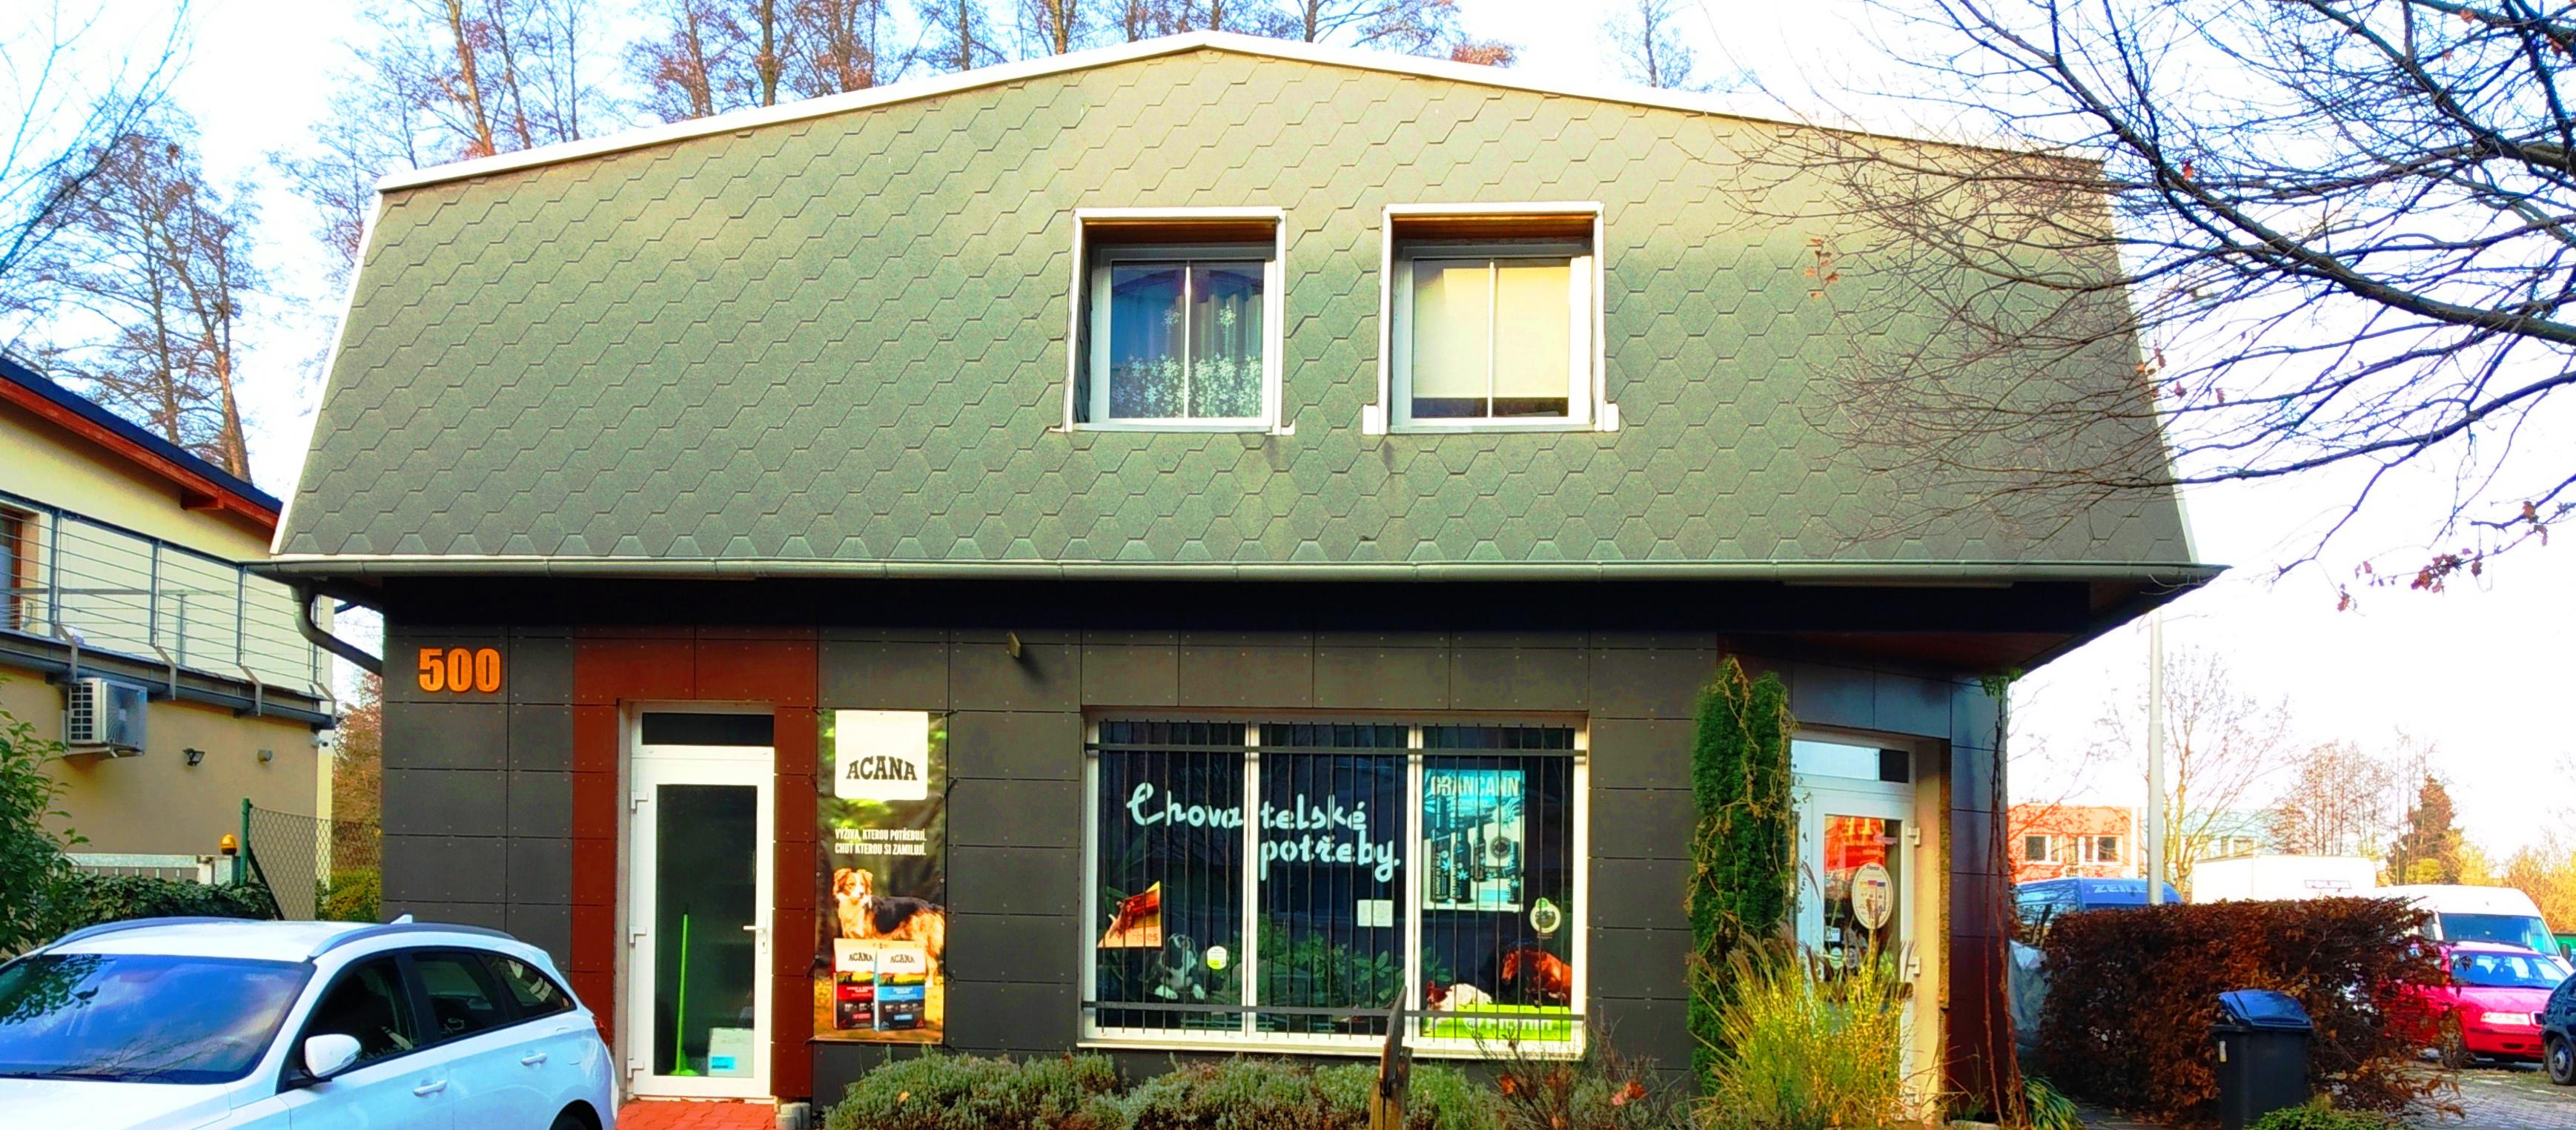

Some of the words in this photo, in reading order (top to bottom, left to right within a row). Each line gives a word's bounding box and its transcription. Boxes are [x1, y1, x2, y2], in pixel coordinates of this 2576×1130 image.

[419, 648, 500, 692] 500
[846, 756, 918, 781] ACANA
[862, 828, 889, 840] KTEROU
[855, 842, 883, 855] KTEROU
[884, 843, 892, 854] SI
[848, 952, 874, 962] ACANA
[890, 954, 915, 963] ACANA
